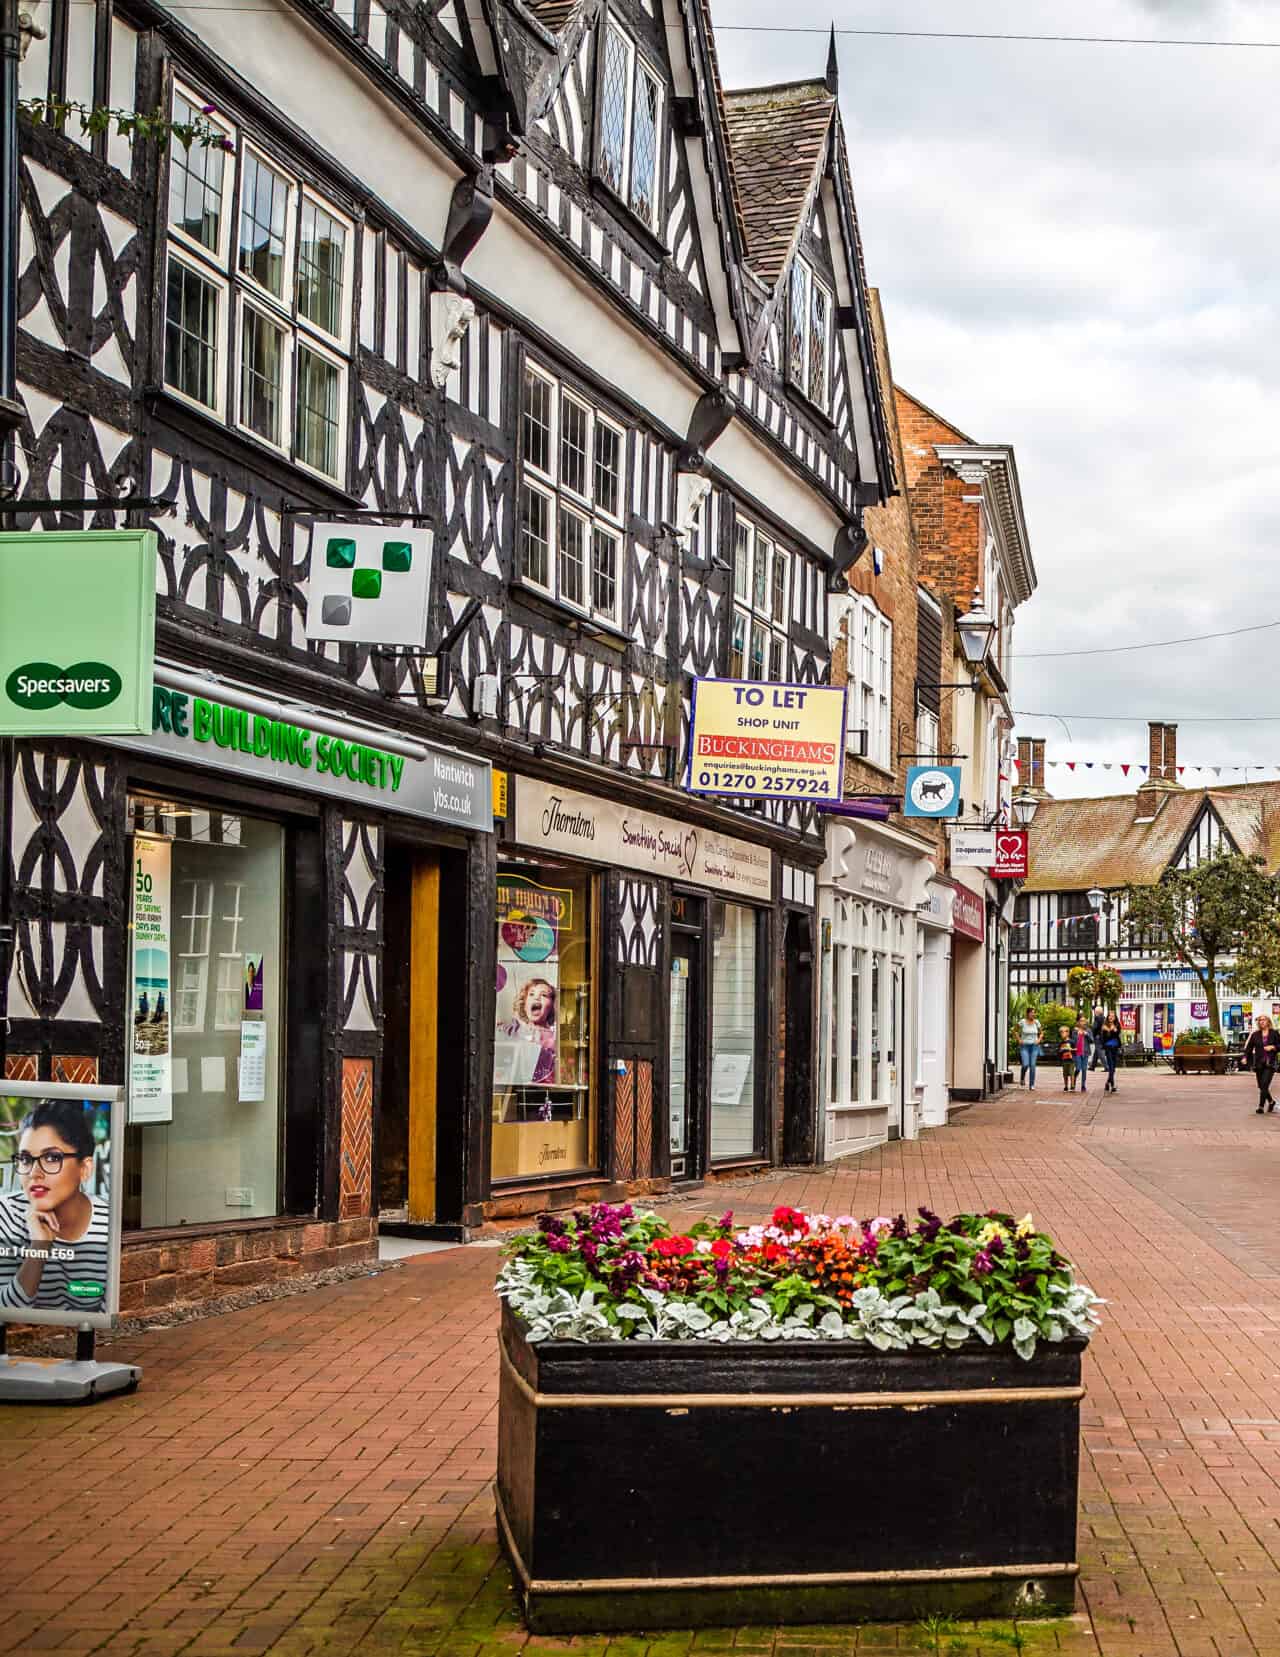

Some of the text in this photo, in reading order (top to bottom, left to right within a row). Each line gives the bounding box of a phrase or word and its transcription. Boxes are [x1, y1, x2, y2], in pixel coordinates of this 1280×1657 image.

[17, 675, 111, 697] Specsavers
[734, 687, 808, 709] TO LET
[737, 717, 800, 730] SHOP UNIT
[193, 698, 312, 768] BUILDING
[316, 735, 405, 792] SOCIETY
[700, 736, 834, 763] BUCKINGHAMS
[433, 757, 474, 788] Nantwich
[703, 761, 827, 777] enquiries@buckinghams.org.uk
[699, 772, 830, 794] 01270 257924
[433, 786, 472, 816] ybs.co.uk
[542, 796, 683, 862] Thorntons Something Special
[21, 1246, 49, 1258] from
[51, 1248, 75, 1260] £69
